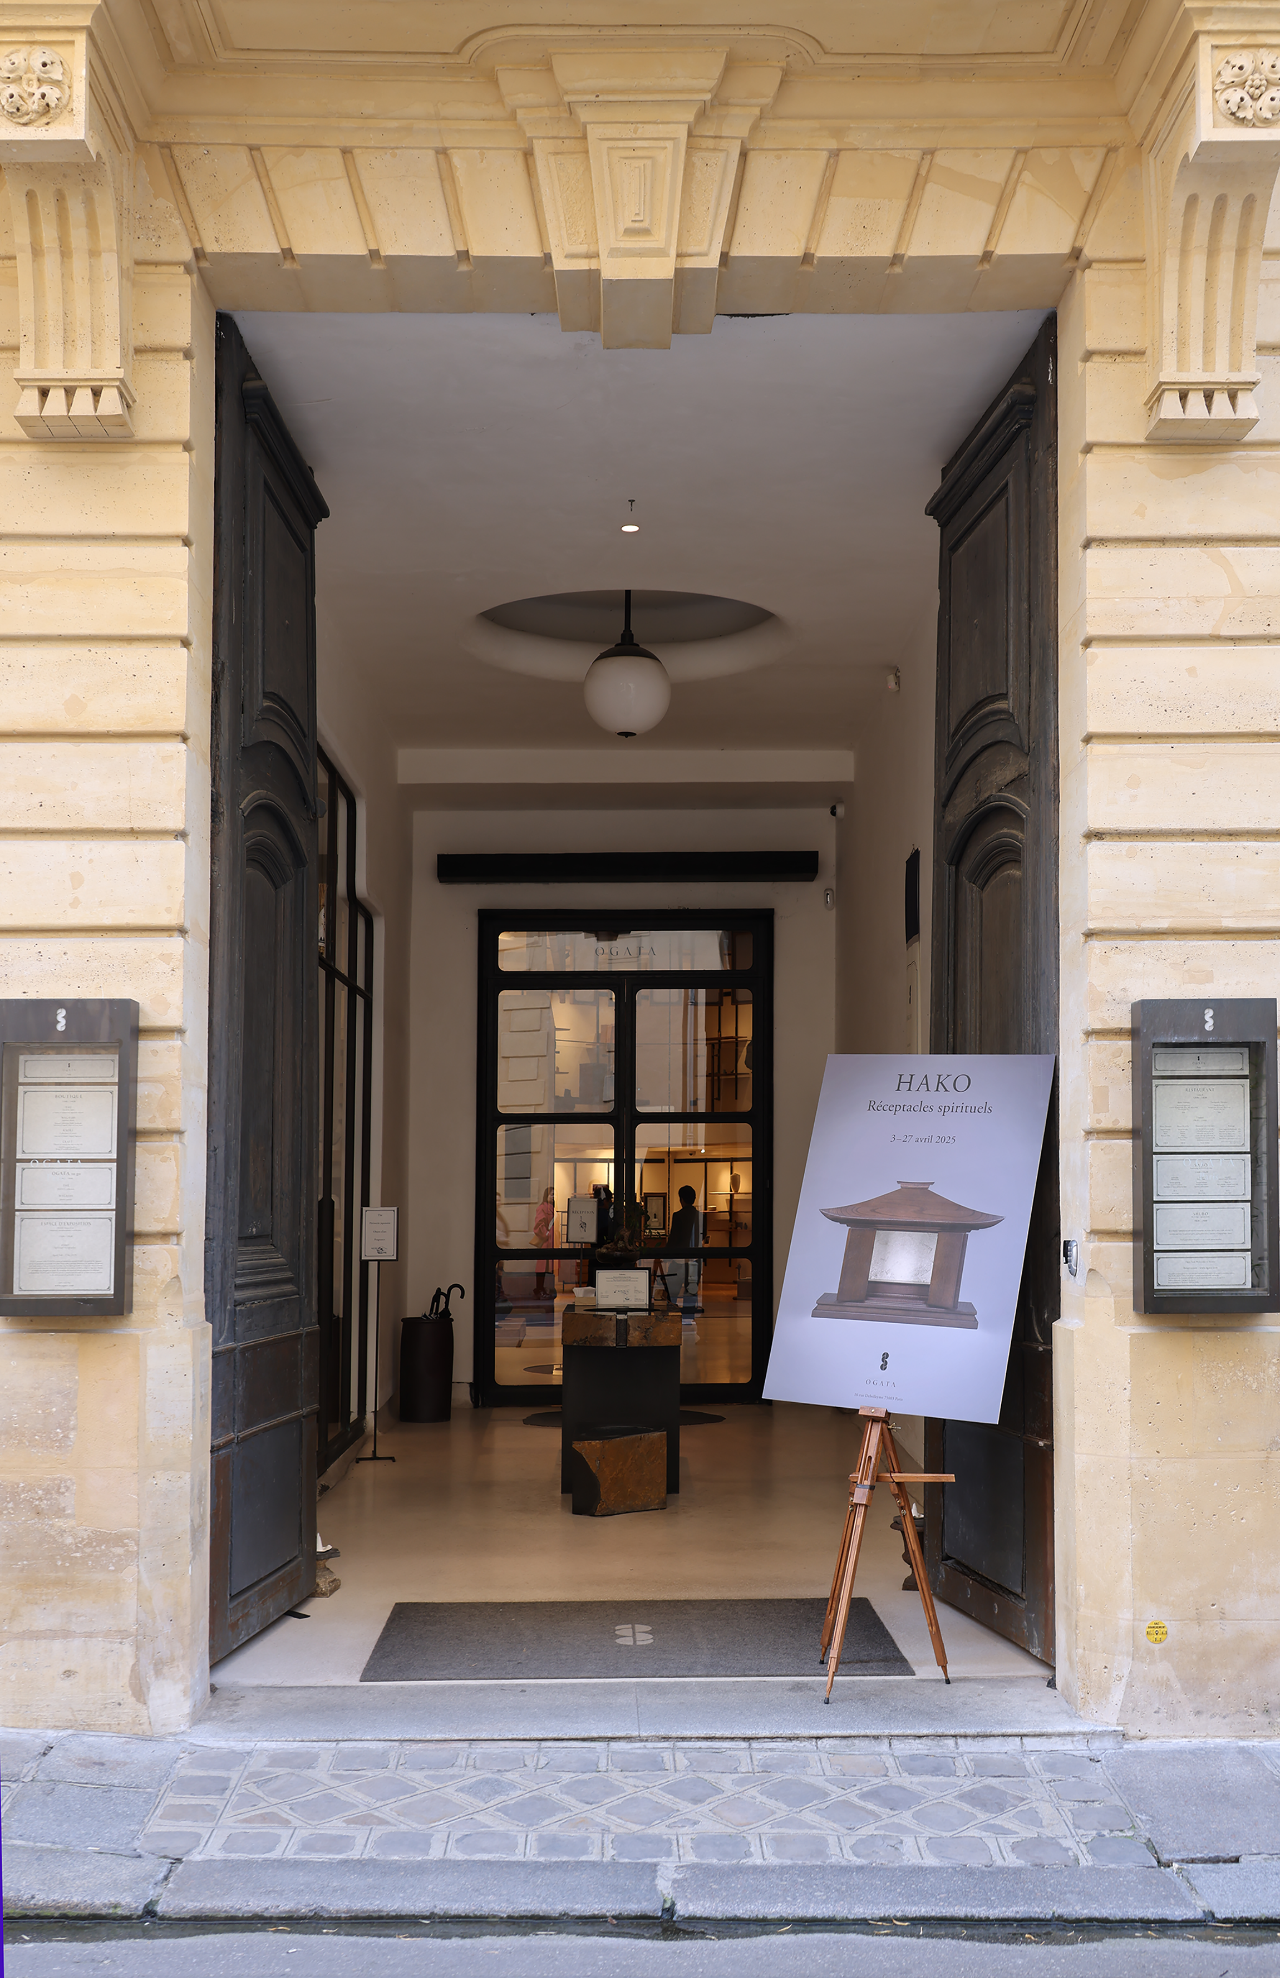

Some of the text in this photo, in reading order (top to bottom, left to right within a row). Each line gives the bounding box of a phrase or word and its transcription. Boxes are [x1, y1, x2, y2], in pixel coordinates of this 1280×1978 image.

[595, 946, 656, 956] OGATA
[895, 1074, 972, 1093] HAKO
[867, 1099, 993, 1116] Réceptacles spirituels
[914, 1134, 933, 1144] avril
[935, 1135, 956, 1144] 2025
[866, 1379, 896, 1387] OGATA
